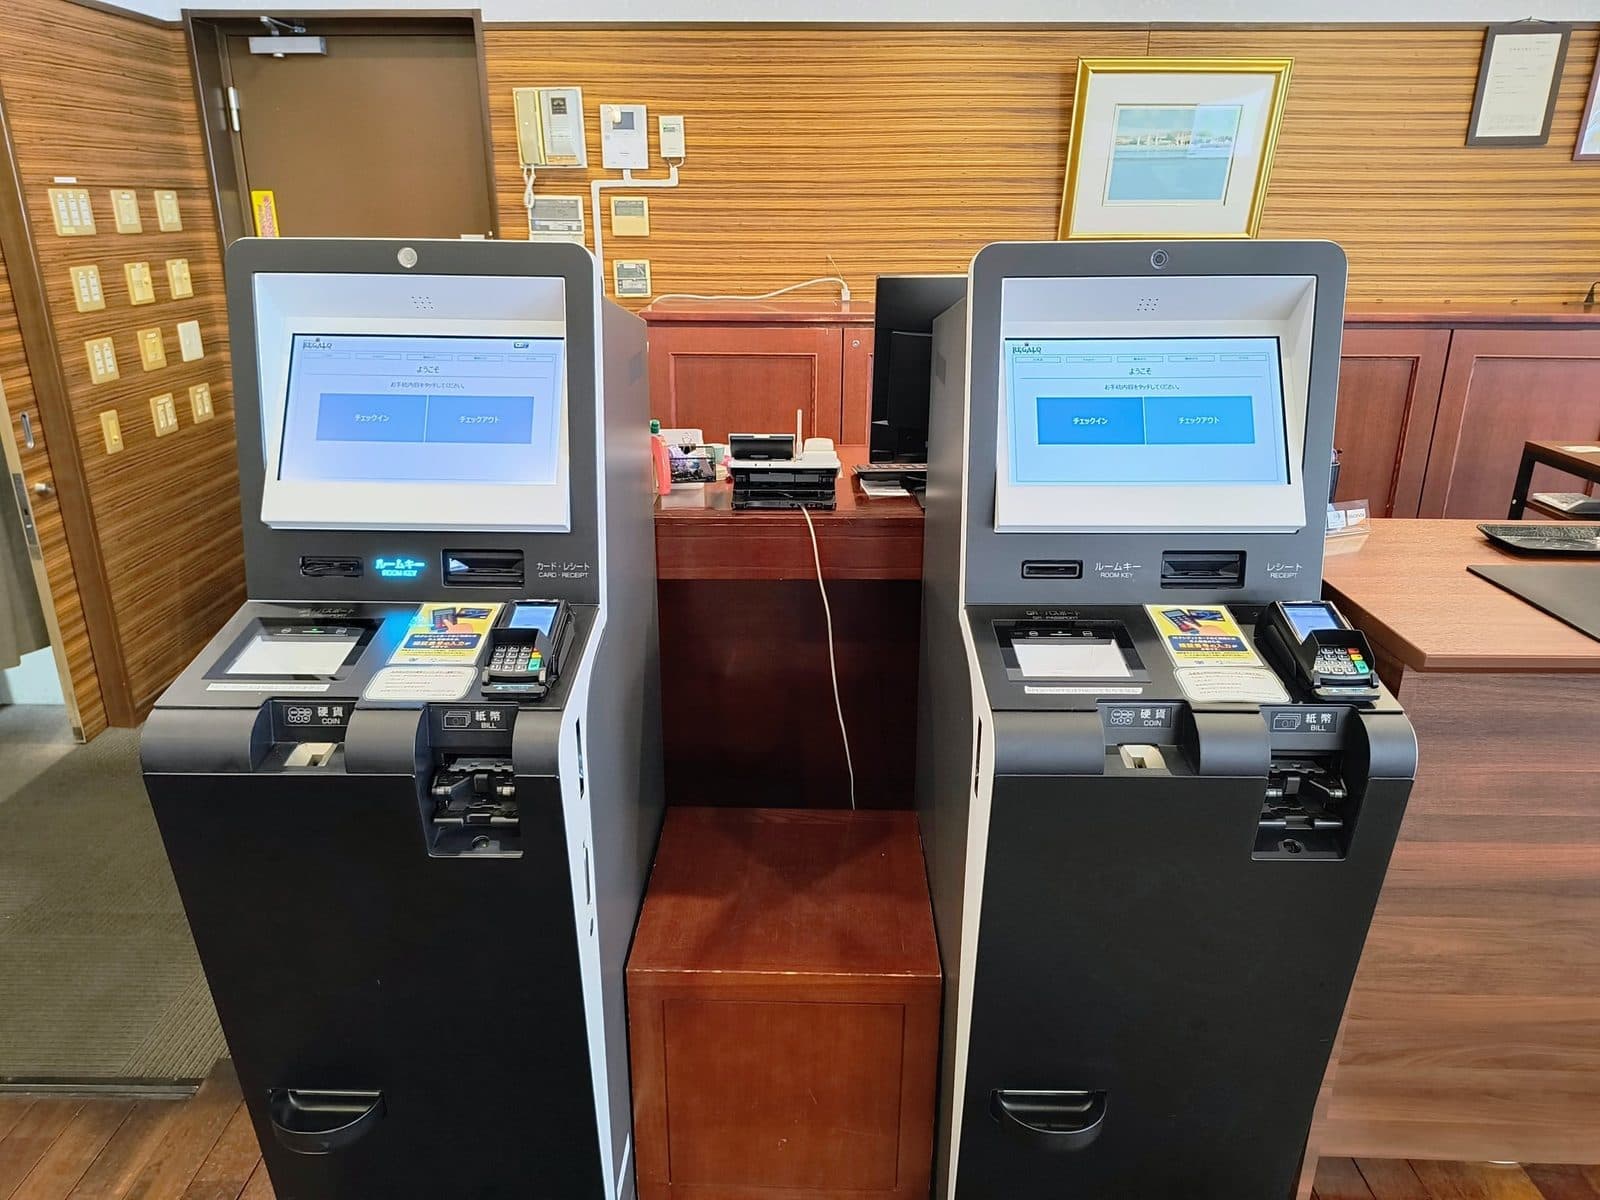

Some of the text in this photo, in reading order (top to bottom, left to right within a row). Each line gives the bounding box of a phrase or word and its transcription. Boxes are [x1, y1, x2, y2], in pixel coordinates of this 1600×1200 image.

[416, 365, 441, 374] ようこそ
[1129, 367, 1152, 375] ようこそ
[354, 413, 390, 423] チェックイン
[458, 414, 500, 425] チェックアウト
[1072, 416, 1109, 426] チェックイン
[1177, 415, 1221, 425] チェックアウト
[375, 559, 426, 570] ルームキー
[1095, 562, 1142, 571] ルームキー
[1267, 562, 1303, 571] レシート
[475, 710, 501, 722] 紙幣
[1305, 713, 1333, 724] 紙幣
[321, 717, 341, 725] COIN
[481, 721, 497, 729] BILL
[1143, 719, 1162, 727] COIN
[1310, 724, 1327, 732] BILL
